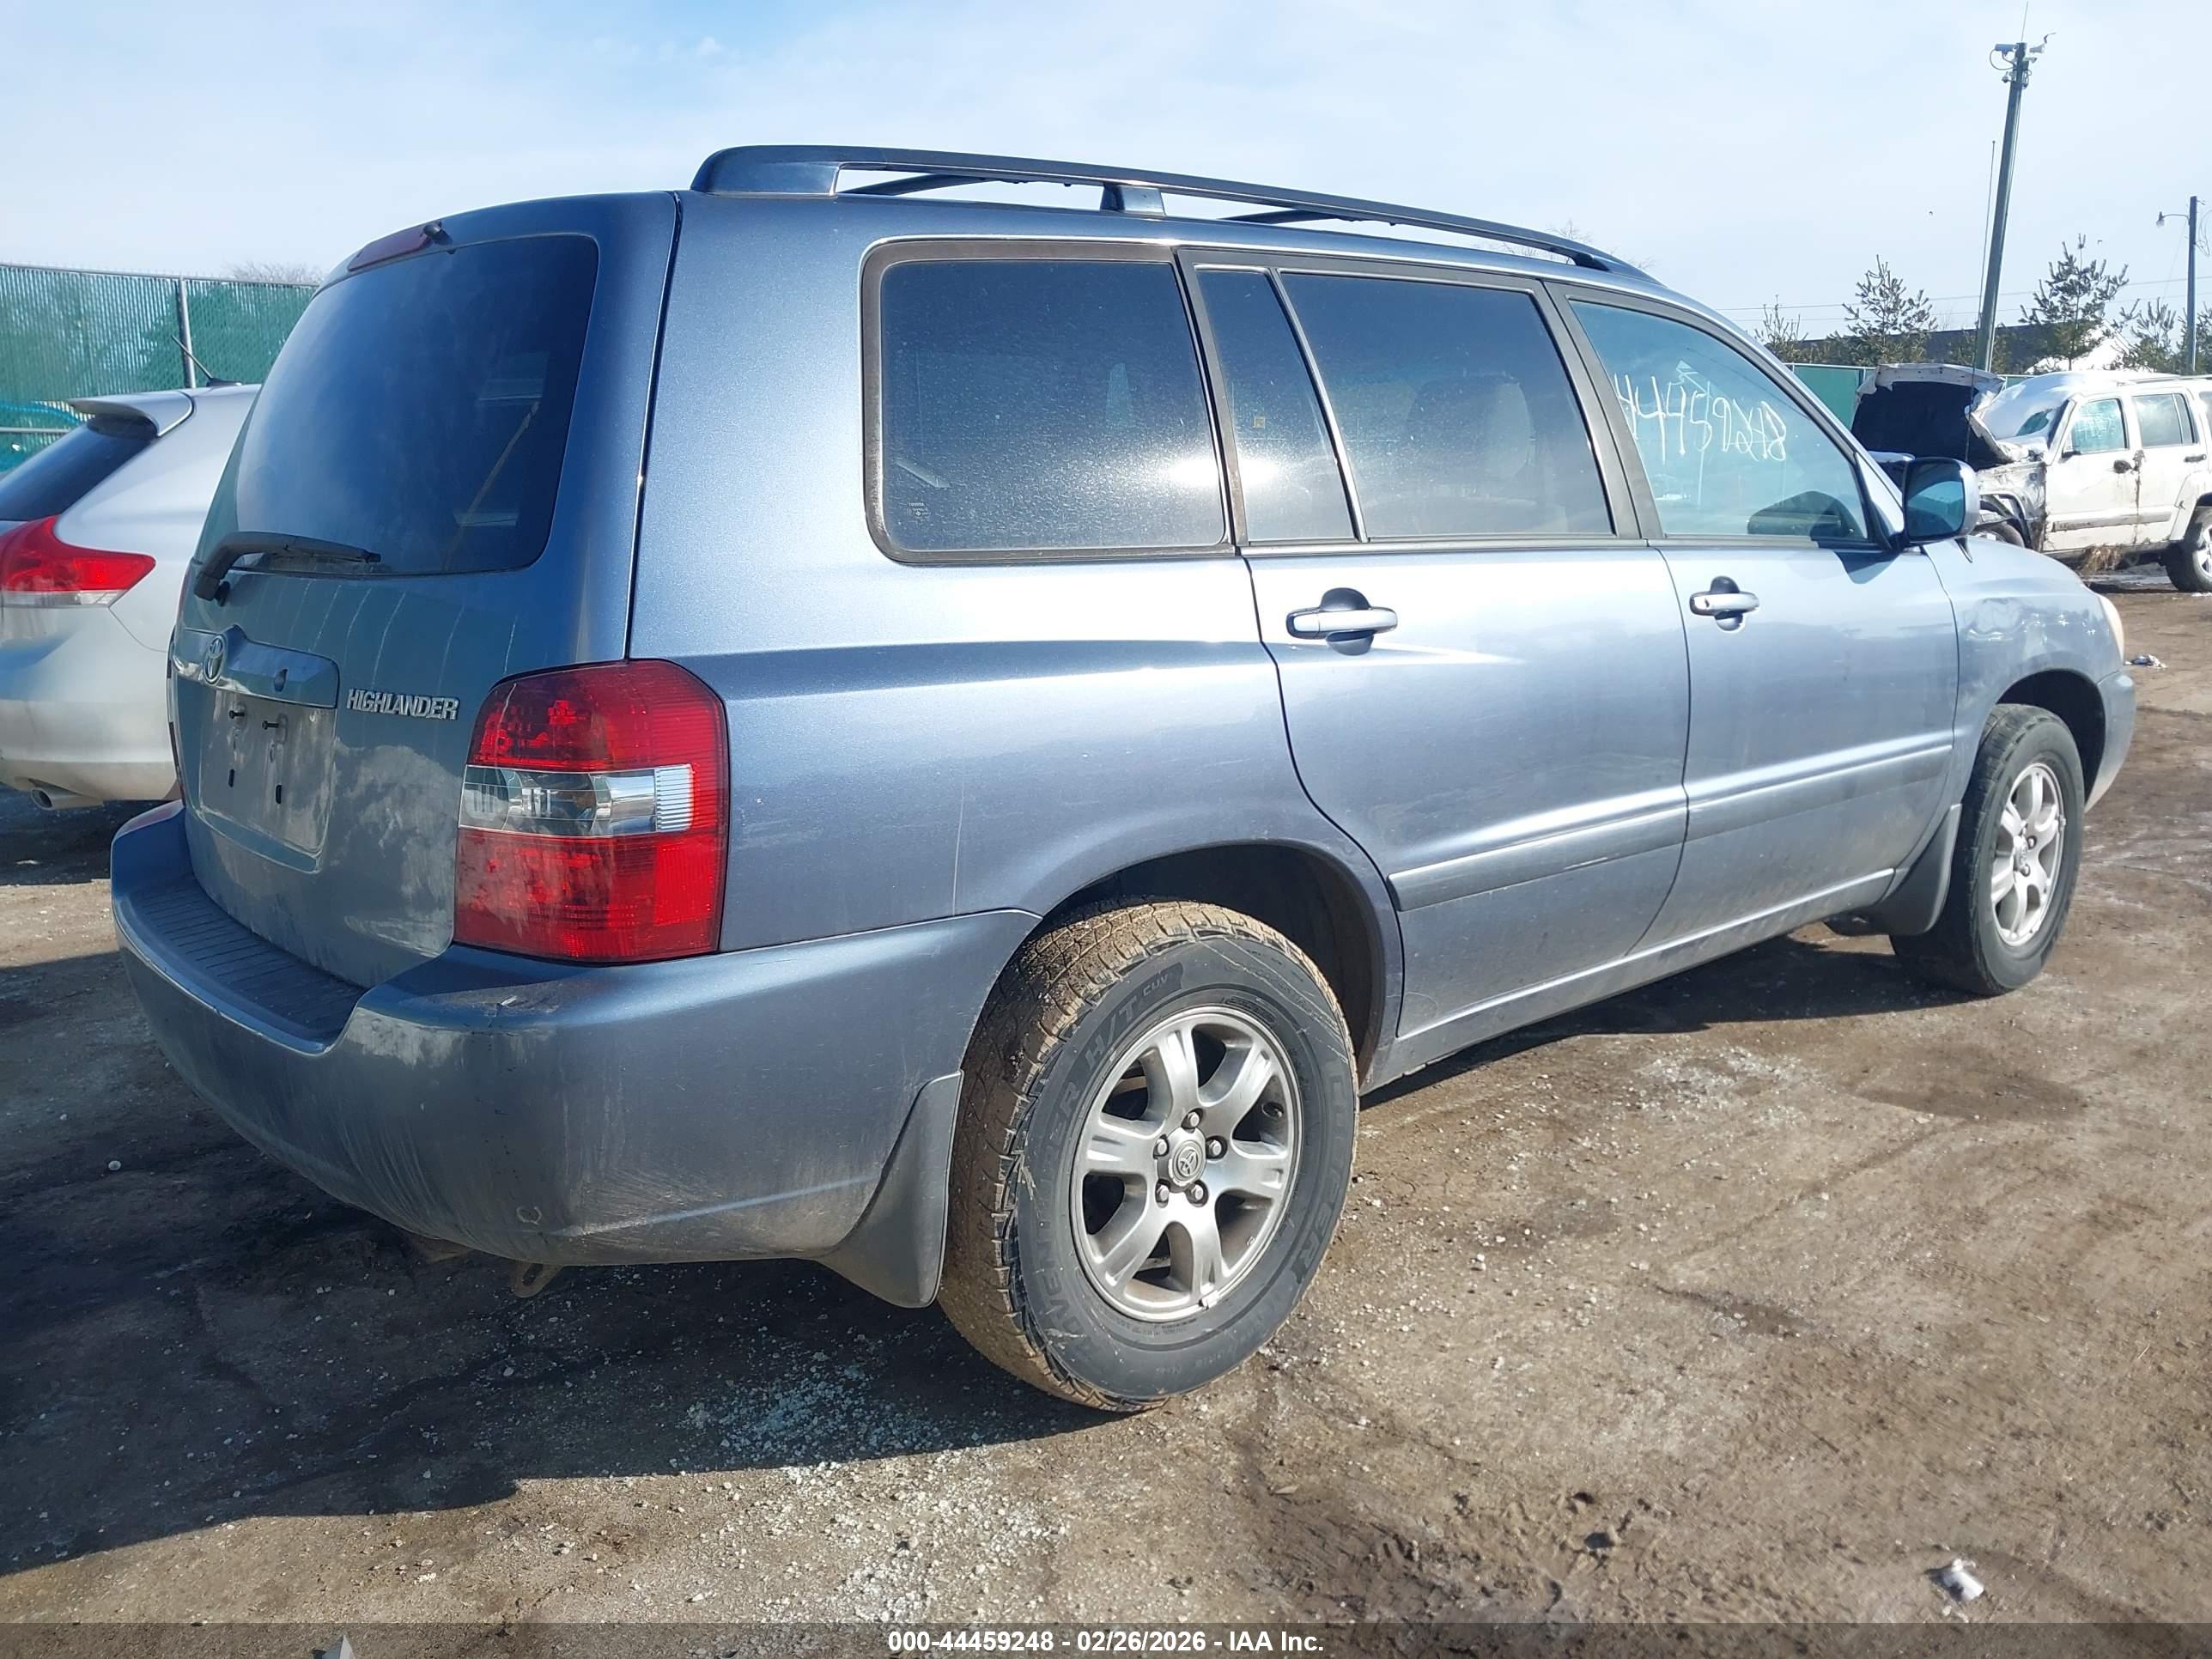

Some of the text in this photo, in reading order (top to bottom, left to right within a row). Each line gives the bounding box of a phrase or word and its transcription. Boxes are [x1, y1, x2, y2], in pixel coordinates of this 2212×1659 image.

[346, 689, 460, 720] HIGHLANDER
[1085, 996, 1140, 1071] H/T
[1142, 974, 1169, 997] CUV
